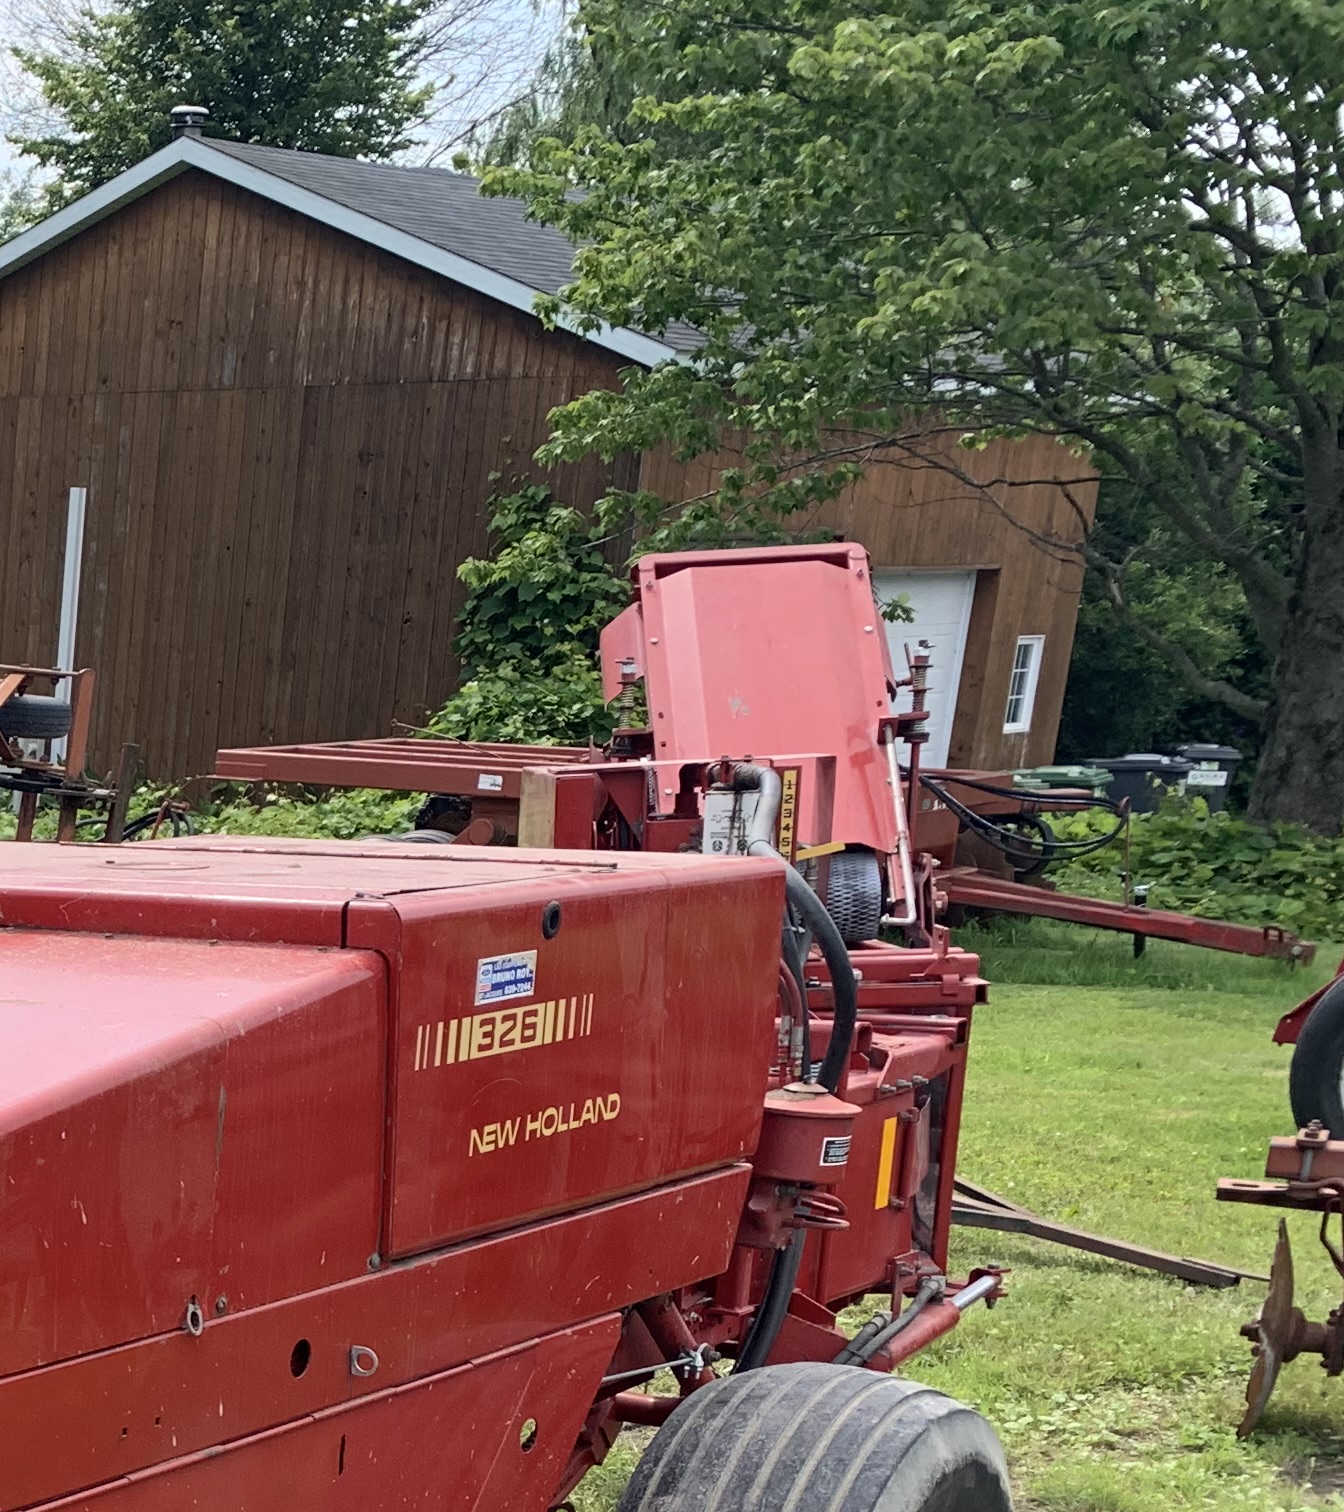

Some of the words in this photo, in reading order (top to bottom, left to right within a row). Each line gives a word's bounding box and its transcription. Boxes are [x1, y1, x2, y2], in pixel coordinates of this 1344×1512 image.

[786, 780, 793, 790] 1
[784, 794, 793, 804] 2
[783, 808, 792, 819] 3
[782, 823, 791, 832] 4
[781, 837, 790, 848] 5
[492, 969, 516, 984] BRUNO
[516, 967, 529, 979] ROY
[477, 1008, 538, 1053] 326
[468, 1116, 522, 1157] NEW
[525, 1092, 621, 1142] HOLLAND
